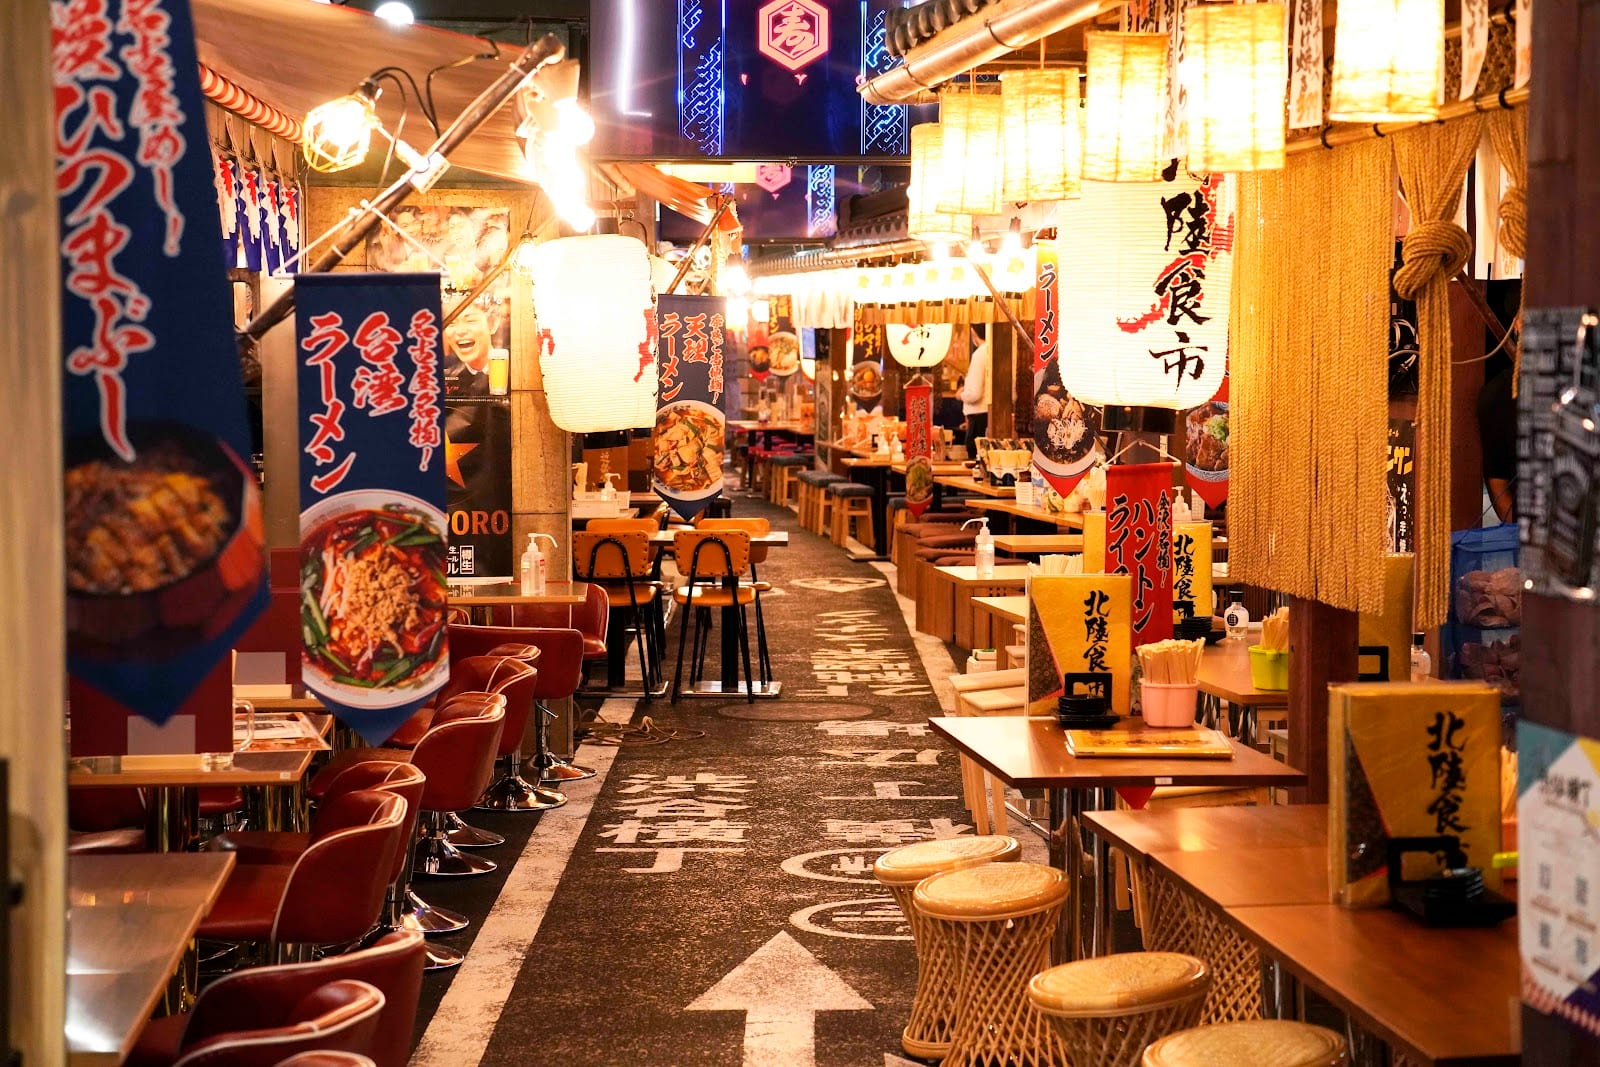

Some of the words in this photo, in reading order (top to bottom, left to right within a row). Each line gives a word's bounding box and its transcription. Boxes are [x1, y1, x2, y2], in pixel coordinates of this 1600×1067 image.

[659, 312, 684, 402] ラーメン
[682, 313, 709, 363] 天理
[1039, 263, 1058, 361] ラーメン
[301, 311, 357, 494] ラーメン
[352, 310, 408, 417] 台湾
[1108, 493, 1130, 575] ライ
[1131, 499, 1155, 634] ハントン
[594, 772, 758, 874] 渋谷横丁
